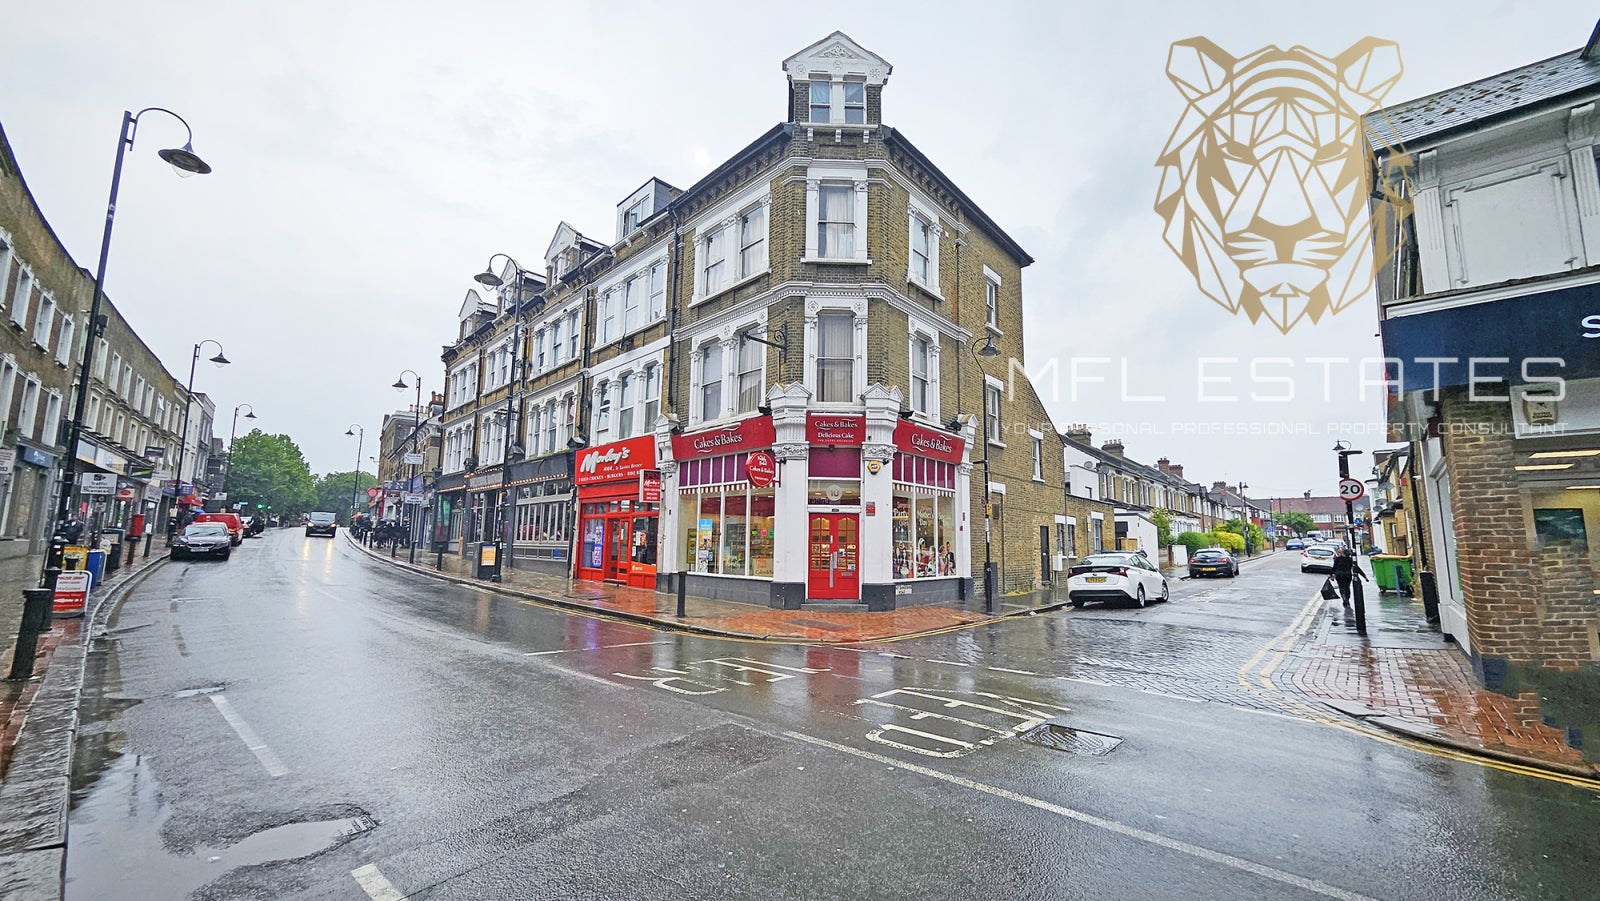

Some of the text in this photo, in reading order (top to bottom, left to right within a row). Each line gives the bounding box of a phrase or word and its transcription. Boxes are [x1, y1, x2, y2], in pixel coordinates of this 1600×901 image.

[694, 431, 743, 450] Cakes & Bakes
[911, 433, 930, 448] Cakes
[935, 439, 952, 453] Bakes
[580, 446, 631, 474] Morley's
[1340, 484, 1361, 494] 20
